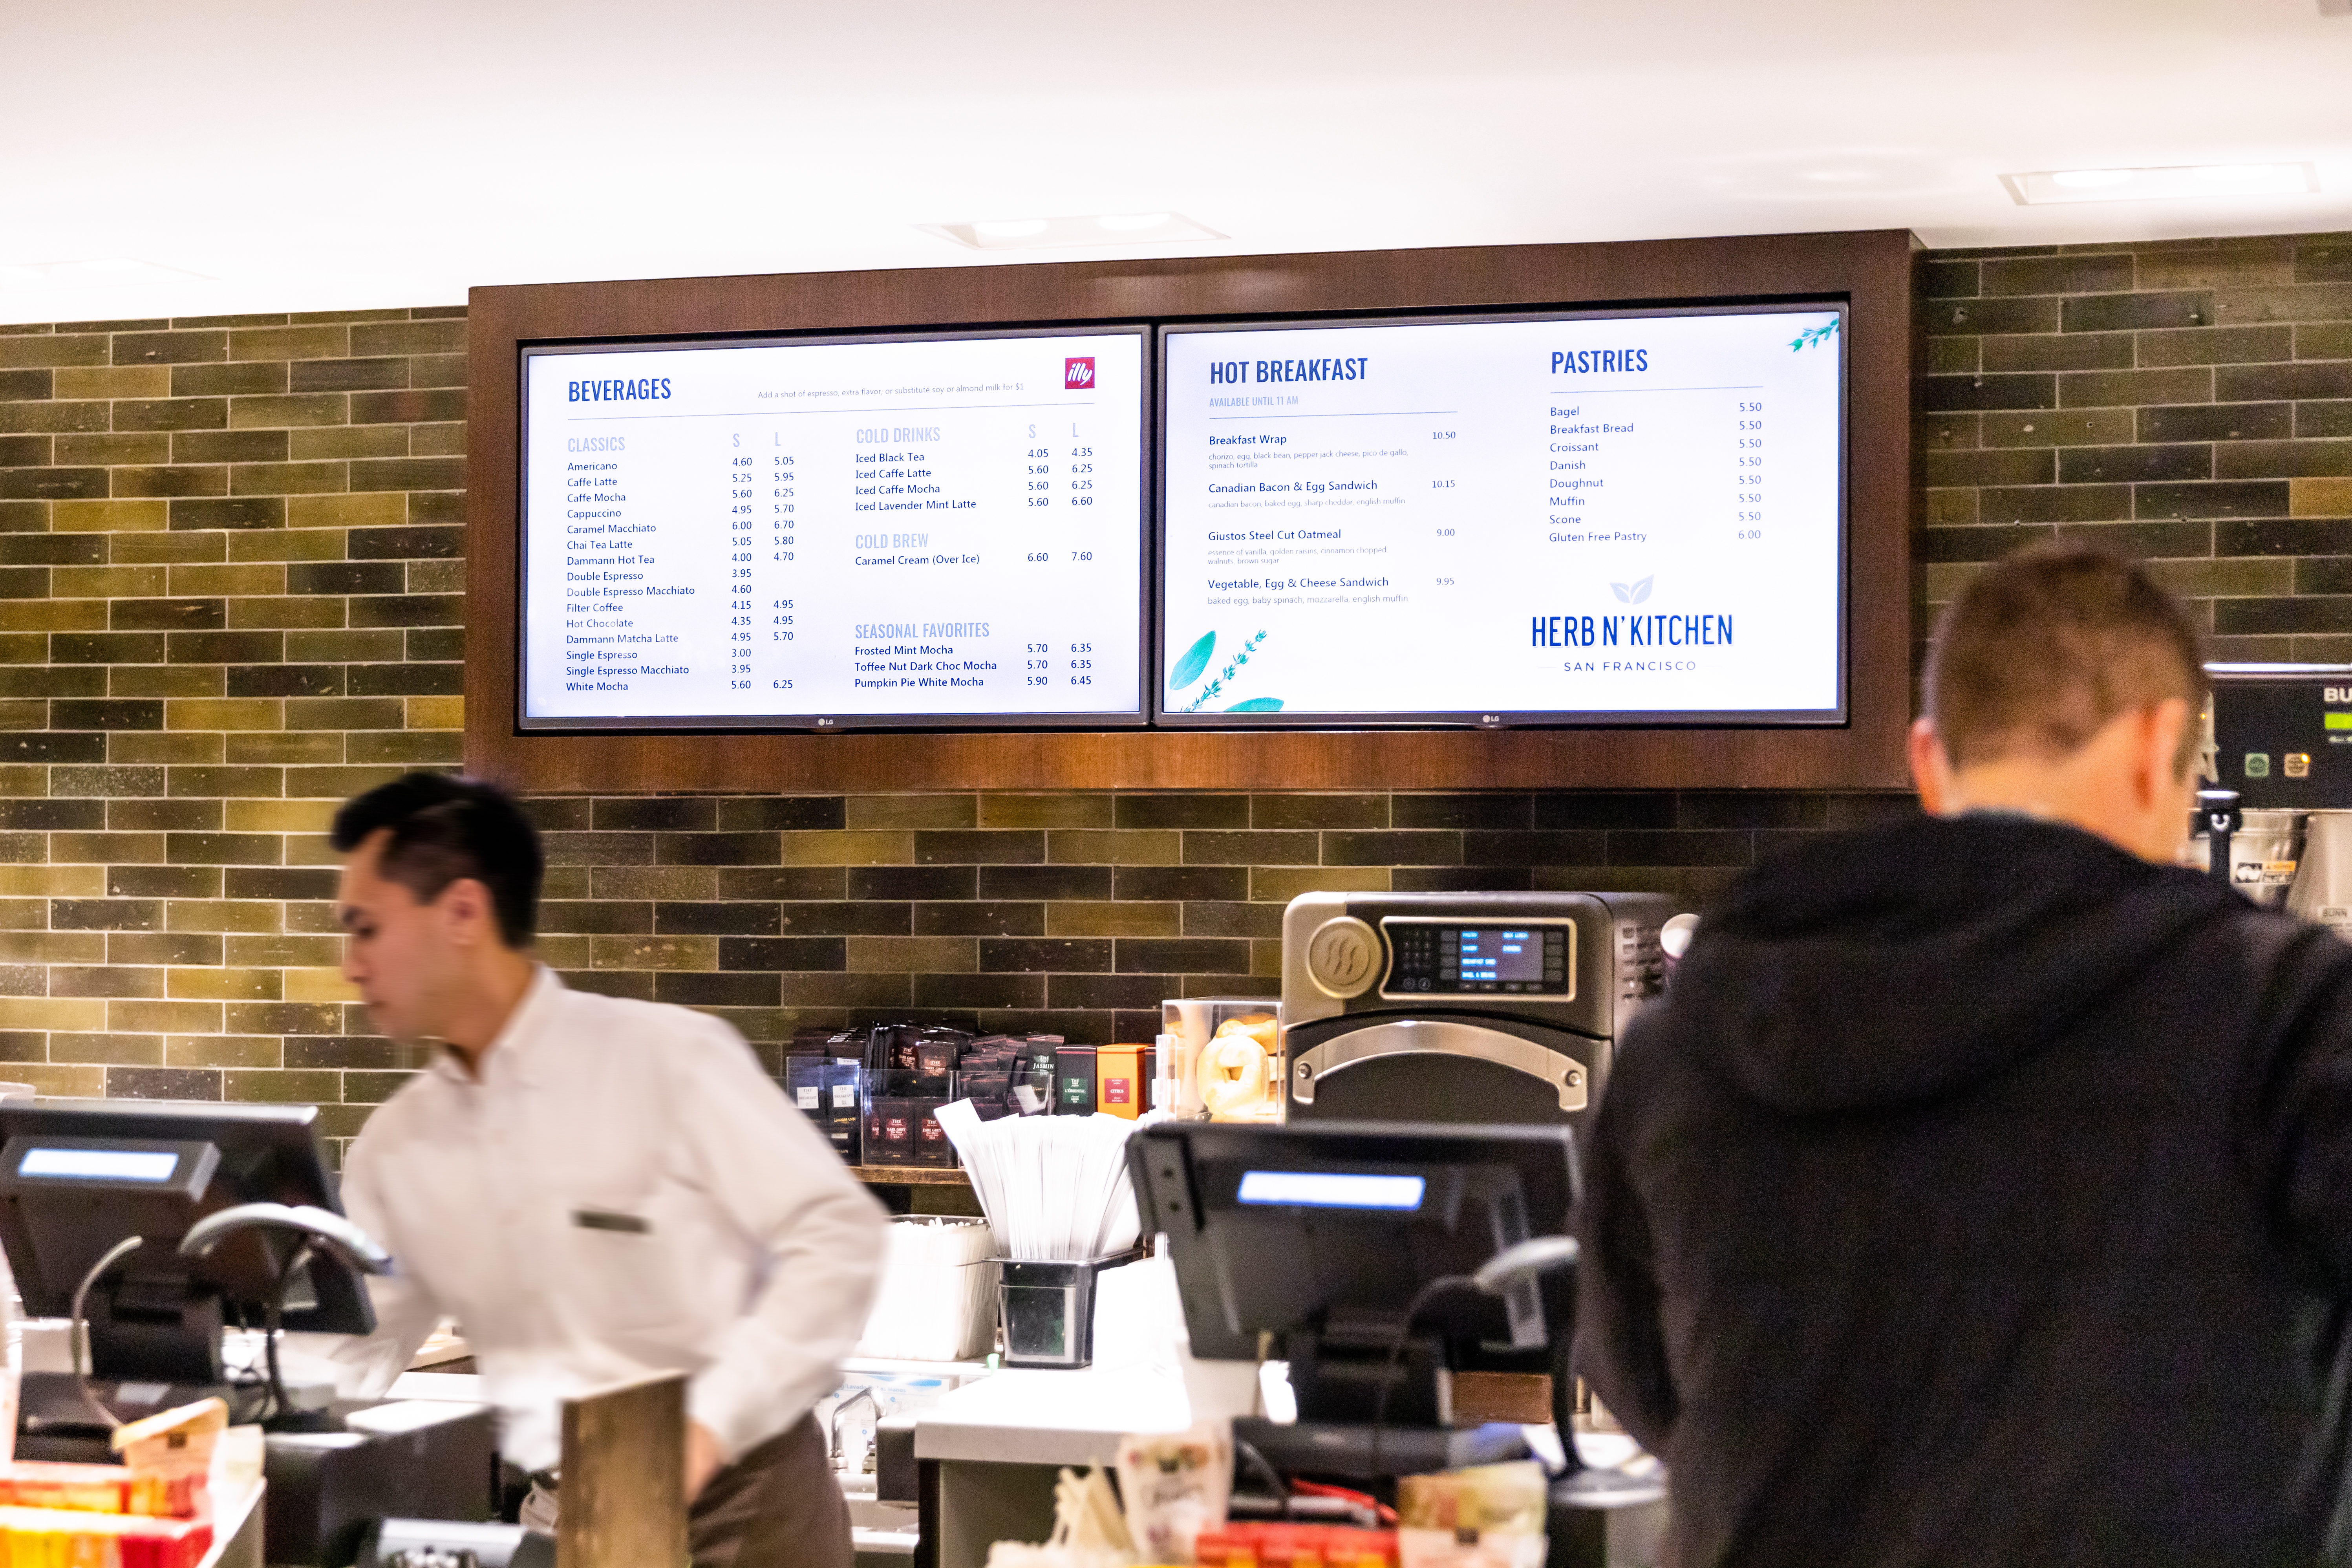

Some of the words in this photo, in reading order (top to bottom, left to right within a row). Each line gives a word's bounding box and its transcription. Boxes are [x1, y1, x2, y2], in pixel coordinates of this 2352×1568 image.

[1552, 349, 1648, 374] PASTRIES
[1067, 362, 1093, 386] illy
[1211, 361, 1249, 384] HOT
[1256, 357, 1368, 382] BREAKFAST
[569, 378, 671, 402] BEVERAGES
[1210, 397, 1249, 406] AVAILABLE
[1253, 397, 1274, 406] UNTIL
[1277, 397, 1283, 405] 11
[1287, 396, 1298, 404] AM
[1551, 406, 1579, 418] Bagel
[1740, 402, 1762, 412] 5.50
[857, 428, 888, 443] COLD
[894, 427, 940, 442] DRINKS
[1029, 424, 1035, 438] S
[1073, 423, 1078, 437] L
[1551, 424, 1599, 434] Breakfast
[1603, 423, 1633, 433] Bread
[1740, 421, 1761, 430] 5.50
[568, 437, 625, 452] CLASSICS
[733, 434, 740, 447] S
[775, 432, 781, 446] L
[1209, 435, 1256, 445] Breakfast
[1259, 435, 1287, 446] Wrap
[1433, 431, 1456, 439] 10.50
[1550, 443, 1598, 452] Croissant
[856, 453, 876, 463] Iced
[879, 452, 904, 462] Black
[907, 452, 924, 461] Tea
[1028, 449, 1048, 458] 4.05
[1072, 447, 1092, 457] 4.35
[567, 462, 617, 471] Americano
[732, 457, 752, 466] 4.60
[775, 456, 794, 465] 5.05
[1550, 460, 1586, 470] Danish
[567, 478, 591, 487] Caffe
[595, 478, 617, 486] Latte
[733, 473, 752, 482] 5.25
[775, 472, 794, 481] 5.95
[1550, 478, 1603, 490] Doughnut
[1209, 483, 1255, 493] Canadian
[1259, 483, 1290, 492] Bacon
[1293, 482, 1302, 491] &
[1306, 481, 1325, 493] Egg
[1329, 480, 1377, 490] Sandwich
[1432, 480, 1455, 488] 10.15
[567, 493, 591, 502] Caffe
[594, 492, 625, 501] Mocha
[1550, 496, 1584, 506] Muffin
[856, 501, 875, 511] Iced
[879, 501, 923, 510] Lavender
[926, 500, 949, 509] Mint
[952, 500, 976, 509] Latte
[567, 509, 621, 520] Cappuccino
[1549, 515, 1581, 524] Scone
[567, 524, 605, 534] Caramel
[608, 523, 656, 533] Macchiato
[1208, 532, 1245, 541] Giustos
[1249, 530, 1273, 540] Steel
[1277, 530, 1295, 539] Cut
[1298, 529, 1341, 539] Oatmeal
[1549, 532, 1584, 542] Gluten
[1588, 532, 1610, 541] Free
[1615, 532, 1646, 543] Pastry
[1739, 530, 1761, 539] 6.00
[567, 541, 587, 550] Chai
[590, 540, 606, 549] Tea
[610, 540, 633, 549] Latte
[856, 534, 888, 549] COLD
[893, 534, 928, 548] BREW
[567, 556, 615, 565] Dammann
[618, 556, 635, 564] Hot
[638, 555, 654, 564] Tea
[855, 556, 894, 565] Caramel
[898, 556, 929, 564] Cream
[933, 555, 959, 565] (Over
[962, 554, 979, 565] Ice)
[1028, 553, 1048, 562] 6.60
[1072, 552, 1092, 561] 7.60
[1208, 579, 1261, 591] Vegetable,
[1266, 579, 1284, 590] Egg
[1288, 578, 1297, 587] &
[1300, 578, 1336, 587] Cheese
[1340, 577, 1388, 587] Sandwich
[1253, 596, 1271, 606] baby
[1273, 596, 1304, 606] spinach,
[1307, 595, 1350, 604] mozzarella,
[1353, 595, 1380, 604] english
[567, 604, 590, 612] Filter
[593, 603, 623, 612] Coffee
[856, 624, 918, 639] SEASONAL
[923, 622, 989, 637] FAVORITES
[1532, 616, 1595, 647] HERB
[855, 646, 891, 655] Frosted
[894, 646, 917, 655] Mint
[920, 645, 953, 654] Mocha
[566, 666, 594, 677] Single
[598, 666, 637, 677] Espresso
[641, 665, 689, 674] Macchiato
[854, 662, 885, 671] Toffee
[889, 662, 907, 671] Nut
[910, 661, 933, 671] Dark
[936, 661, 960, 670] Choc
[964, 660, 997, 670] Mocha
[1564, 662, 1594, 671] SAN
[1603, 661, 1695, 671] FRANCISCO
[566, 682, 594, 691] White
[597, 682, 628, 690] Mocha
[732, 680, 751, 689] 5.60
[773, 680, 793, 689] 6.25
[855, 678, 897, 690] Pumpkin
[901, 678, 915, 687] Pie
[918, 677, 947, 687] White
[951, 677, 984, 686] Mocha
[1028, 676, 1048, 685] 5.90
[1071, 676, 1091, 685] 6.45
